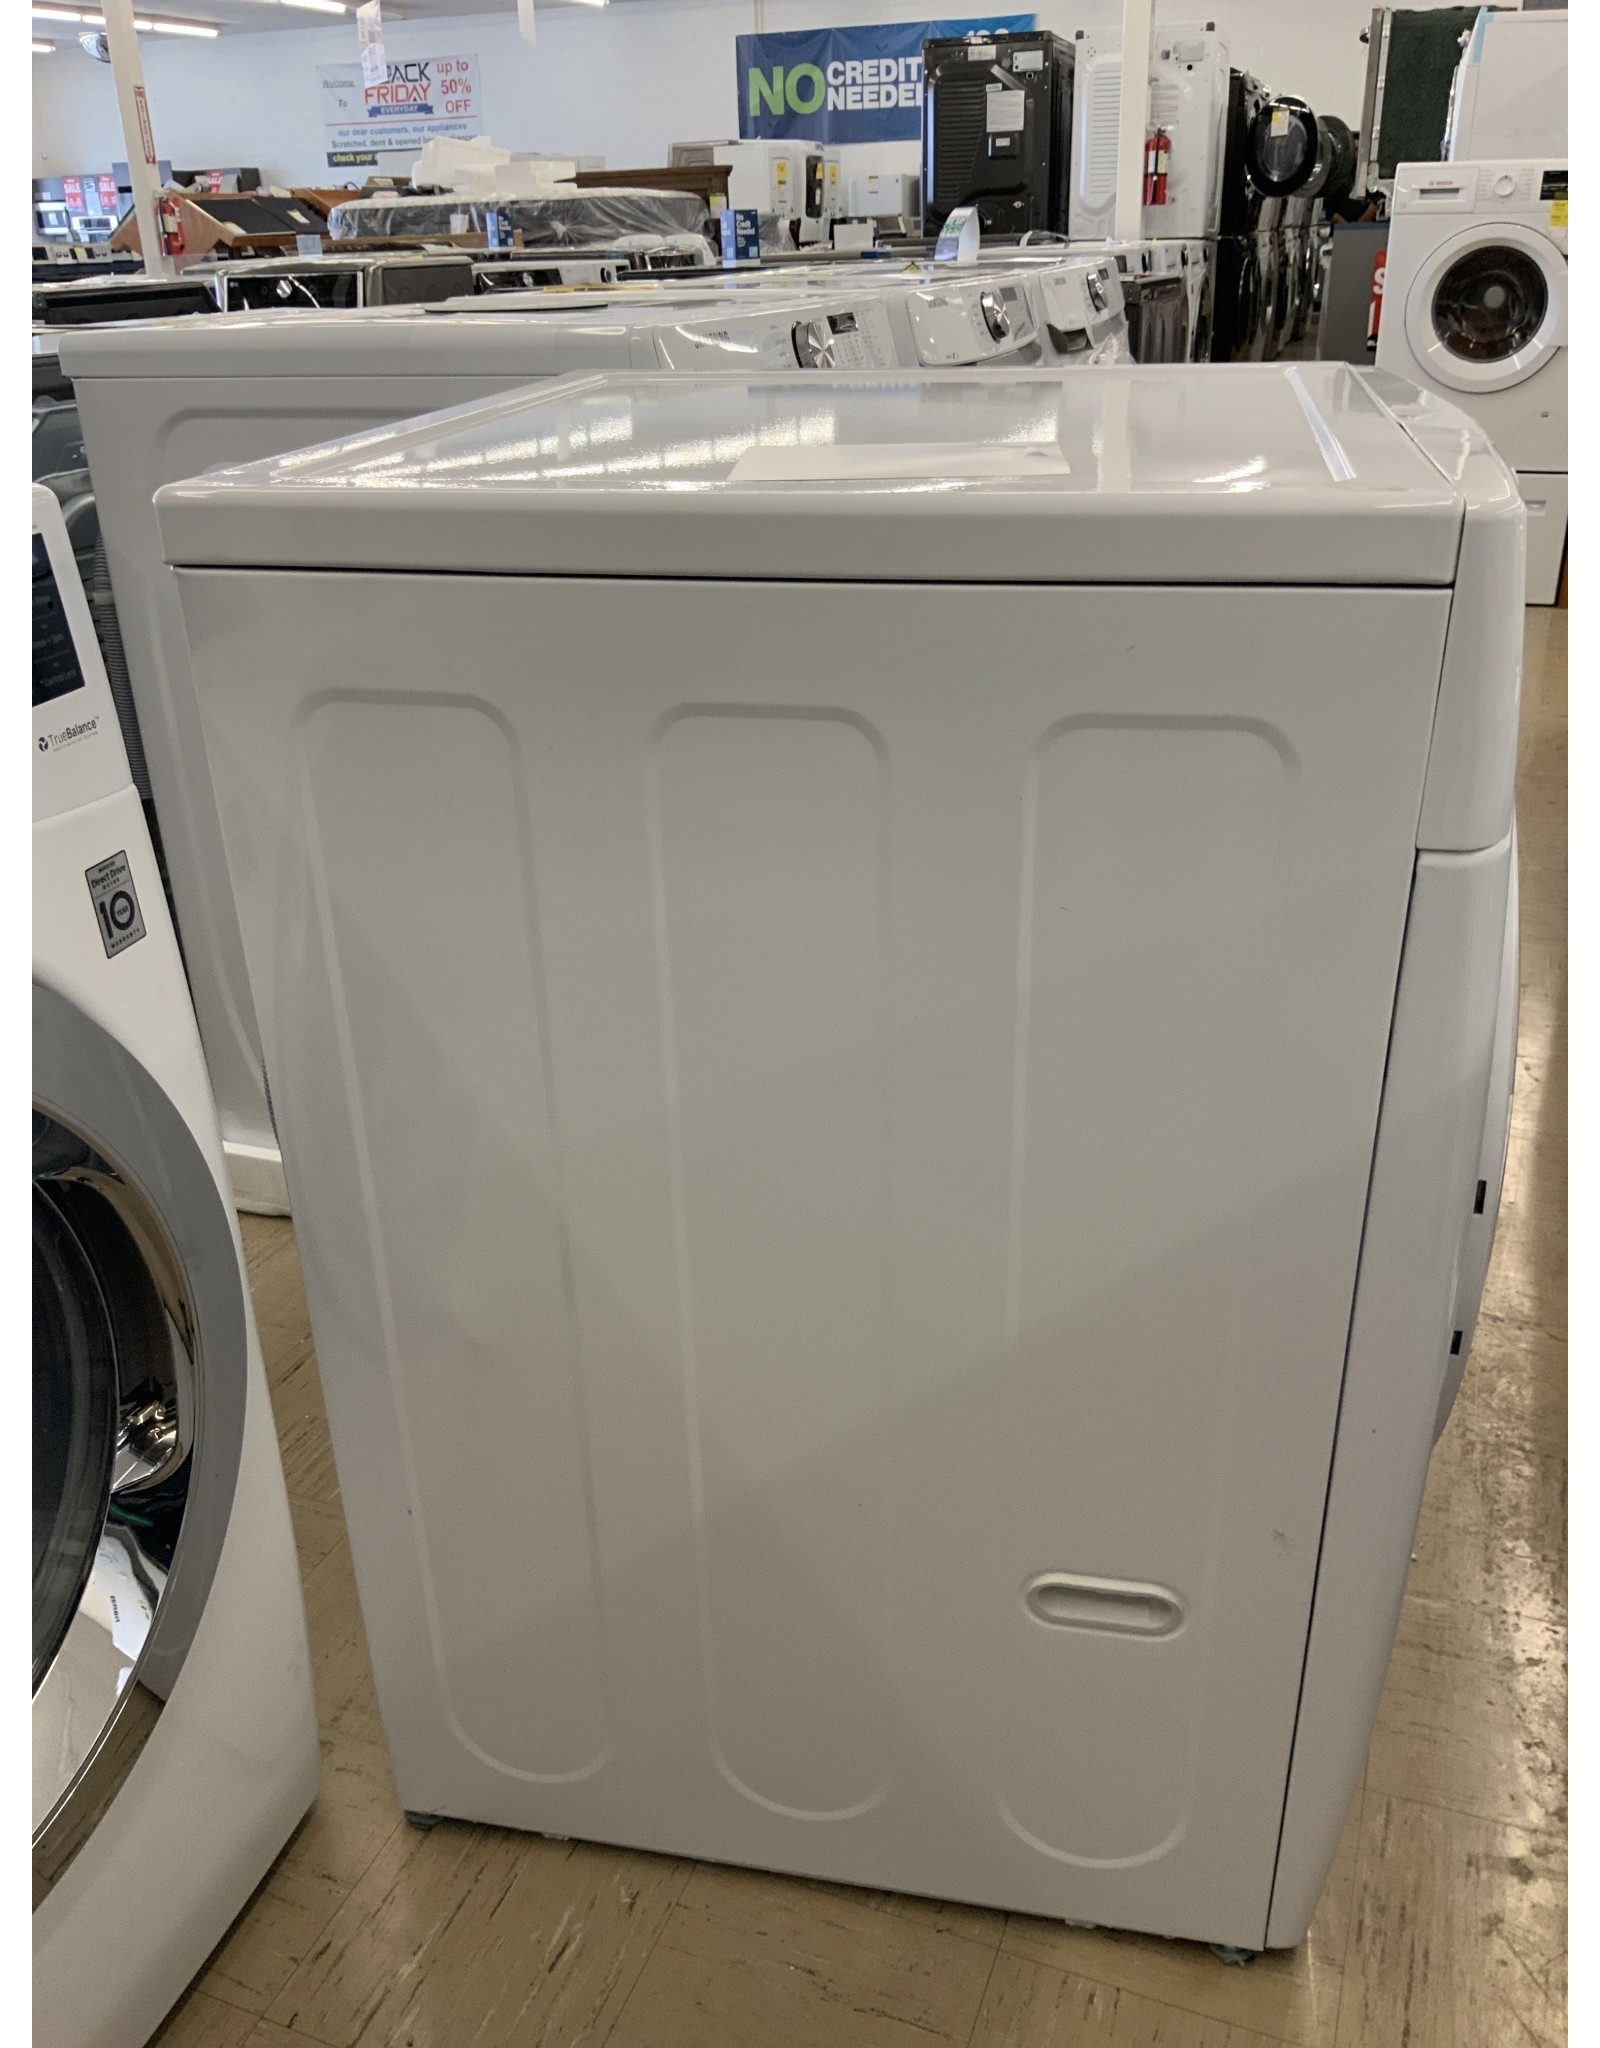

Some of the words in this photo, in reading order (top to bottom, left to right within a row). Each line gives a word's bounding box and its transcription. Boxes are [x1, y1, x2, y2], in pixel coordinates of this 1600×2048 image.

[436, 62, 453, 76] up
[456, 59, 469, 71] to
[827, 56, 922, 86] CREDIT
[365, 82, 431, 105] FRIDAY
[441, 77, 472, 95] 50%
[748, 63, 826, 117] NO
[338, 98, 348, 108] To
[380, 105, 418, 115] EVERYDAY
[445, 99, 471, 114] OFF
[413, 125, 425, 133] our
[427, 122, 467, 133] appliances
[370, 139, 386, 147] dent
[395, 135, 421, 147] opened
[333, 152, 355, 162] check
[356, 152, 373, 164] your
[91, 872, 110, 889] Direct
[110, 864, 126, 879] Drive
[99, 890, 135, 939] 10
